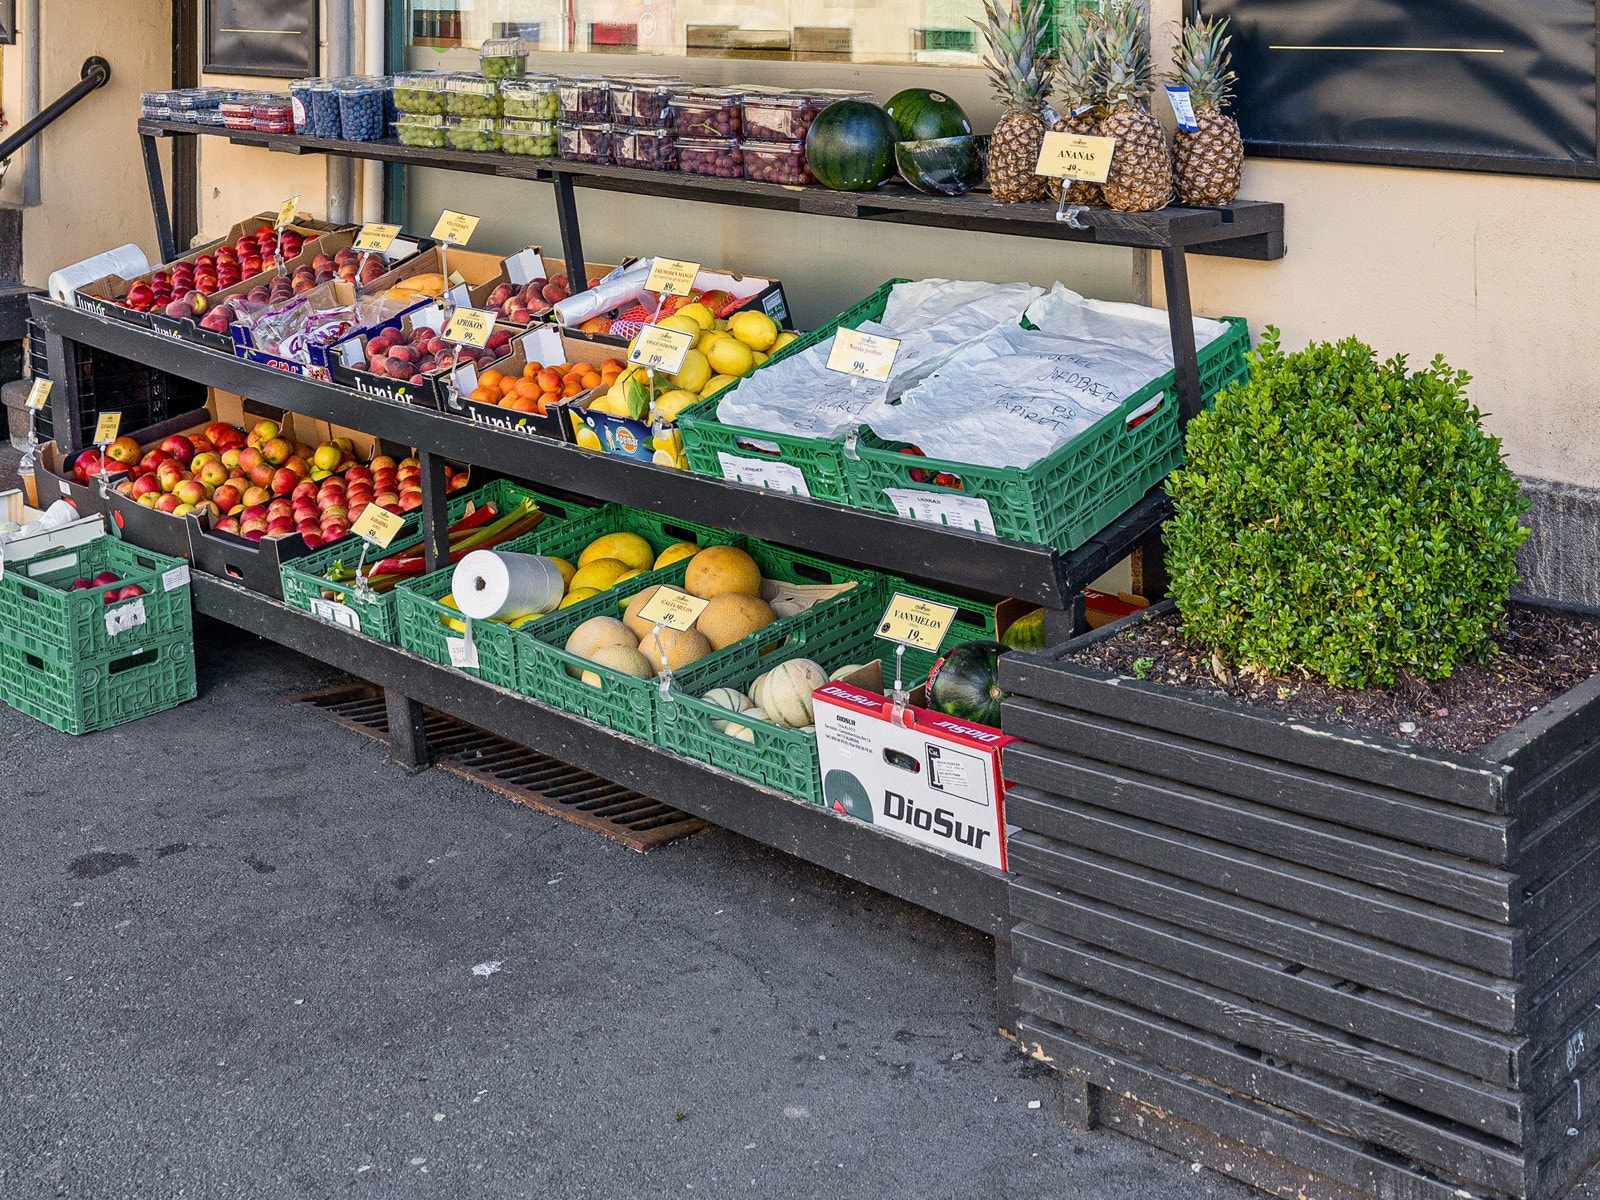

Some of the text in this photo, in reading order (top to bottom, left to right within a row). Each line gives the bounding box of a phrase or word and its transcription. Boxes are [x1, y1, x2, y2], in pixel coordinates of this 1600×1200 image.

[1058, 150, 1095, 161] ANANAS
[455, 318, 485, 330] APRIKOS
[853, 361, 868, 374] 99,-
[354, 376, 414, 405] Junior
[894, 610, 943, 629] VANNMELON
[907, 629, 924, 642] 19,-
[820, 685, 882, 708] DioSur
[933, 719, 1002, 743] DioSur
[883, 789, 991, 850] DioSur
